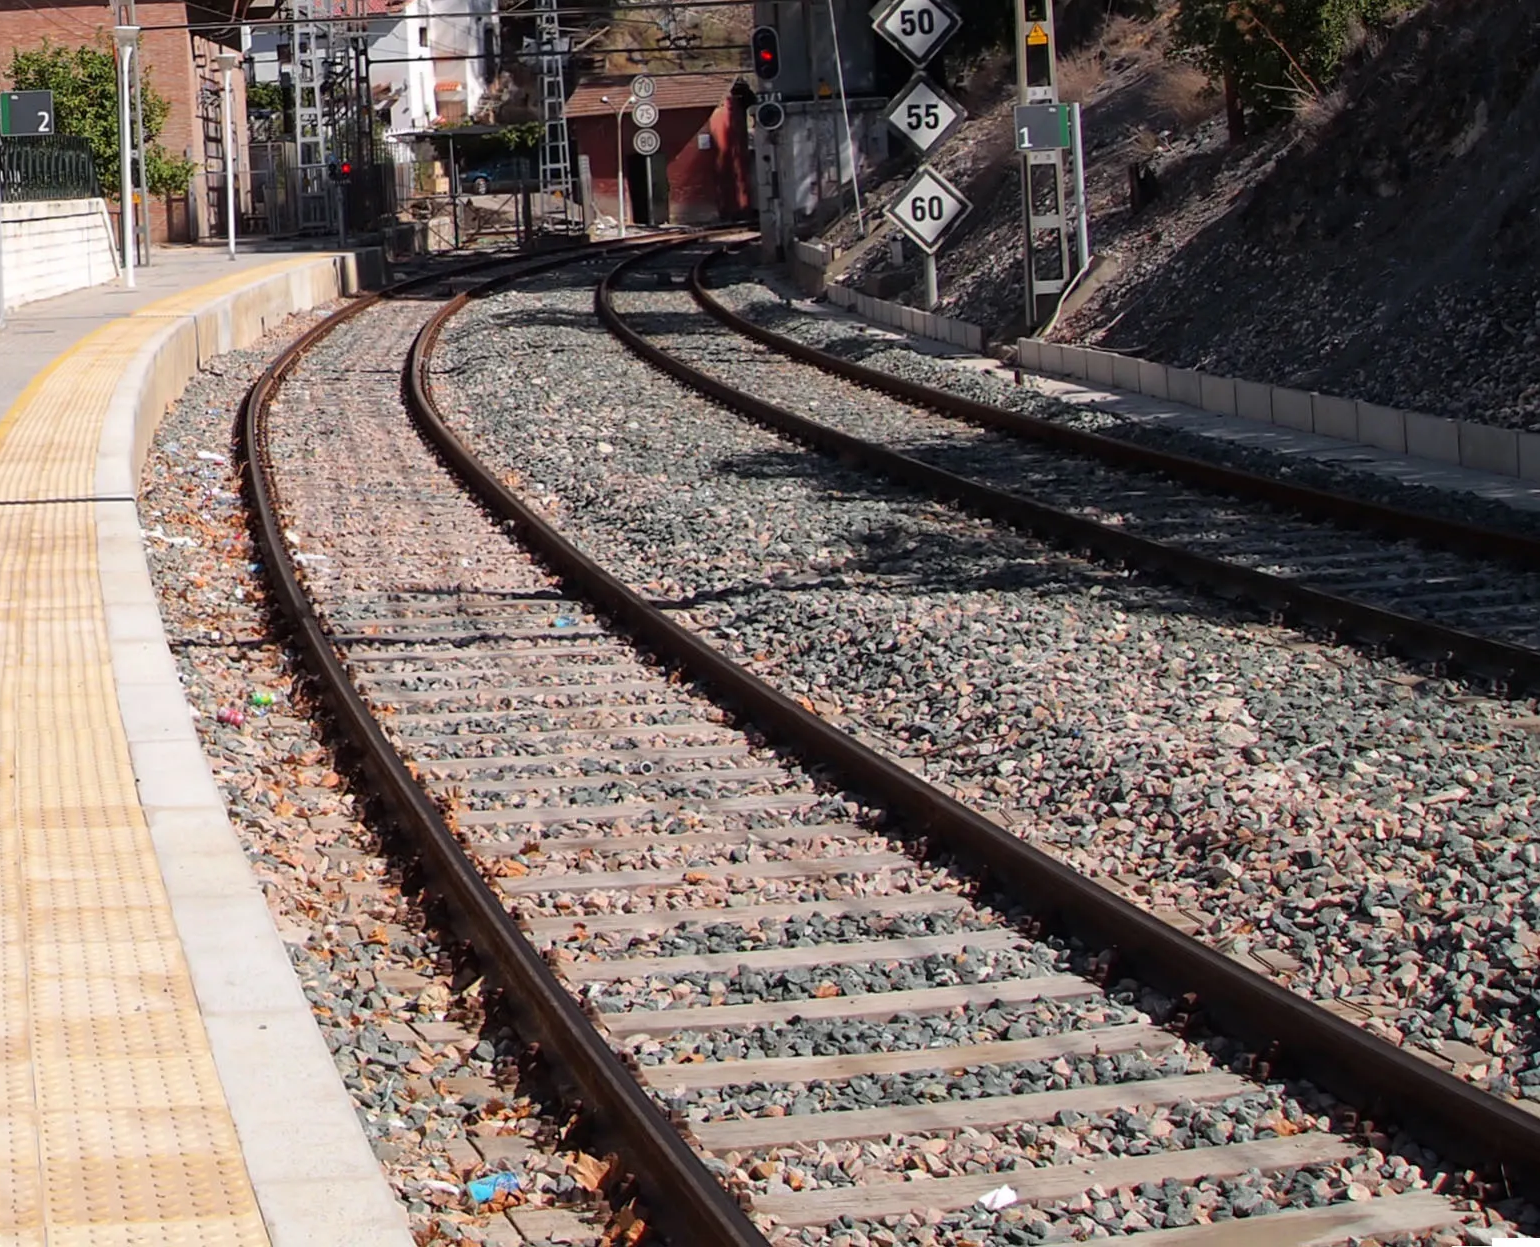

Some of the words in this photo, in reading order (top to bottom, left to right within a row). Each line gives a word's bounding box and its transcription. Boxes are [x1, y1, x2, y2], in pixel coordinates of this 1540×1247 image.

[900, 8, 935, 37] 50
[637, 80, 651, 94] 70
[37, 111, 50, 132] 2
[639, 107, 653, 120] 75
[906, 103, 939, 131] 55
[640, 135, 654, 148] 80
[1019, 127, 1033, 148] 1
[911, 195, 943, 222] 60
